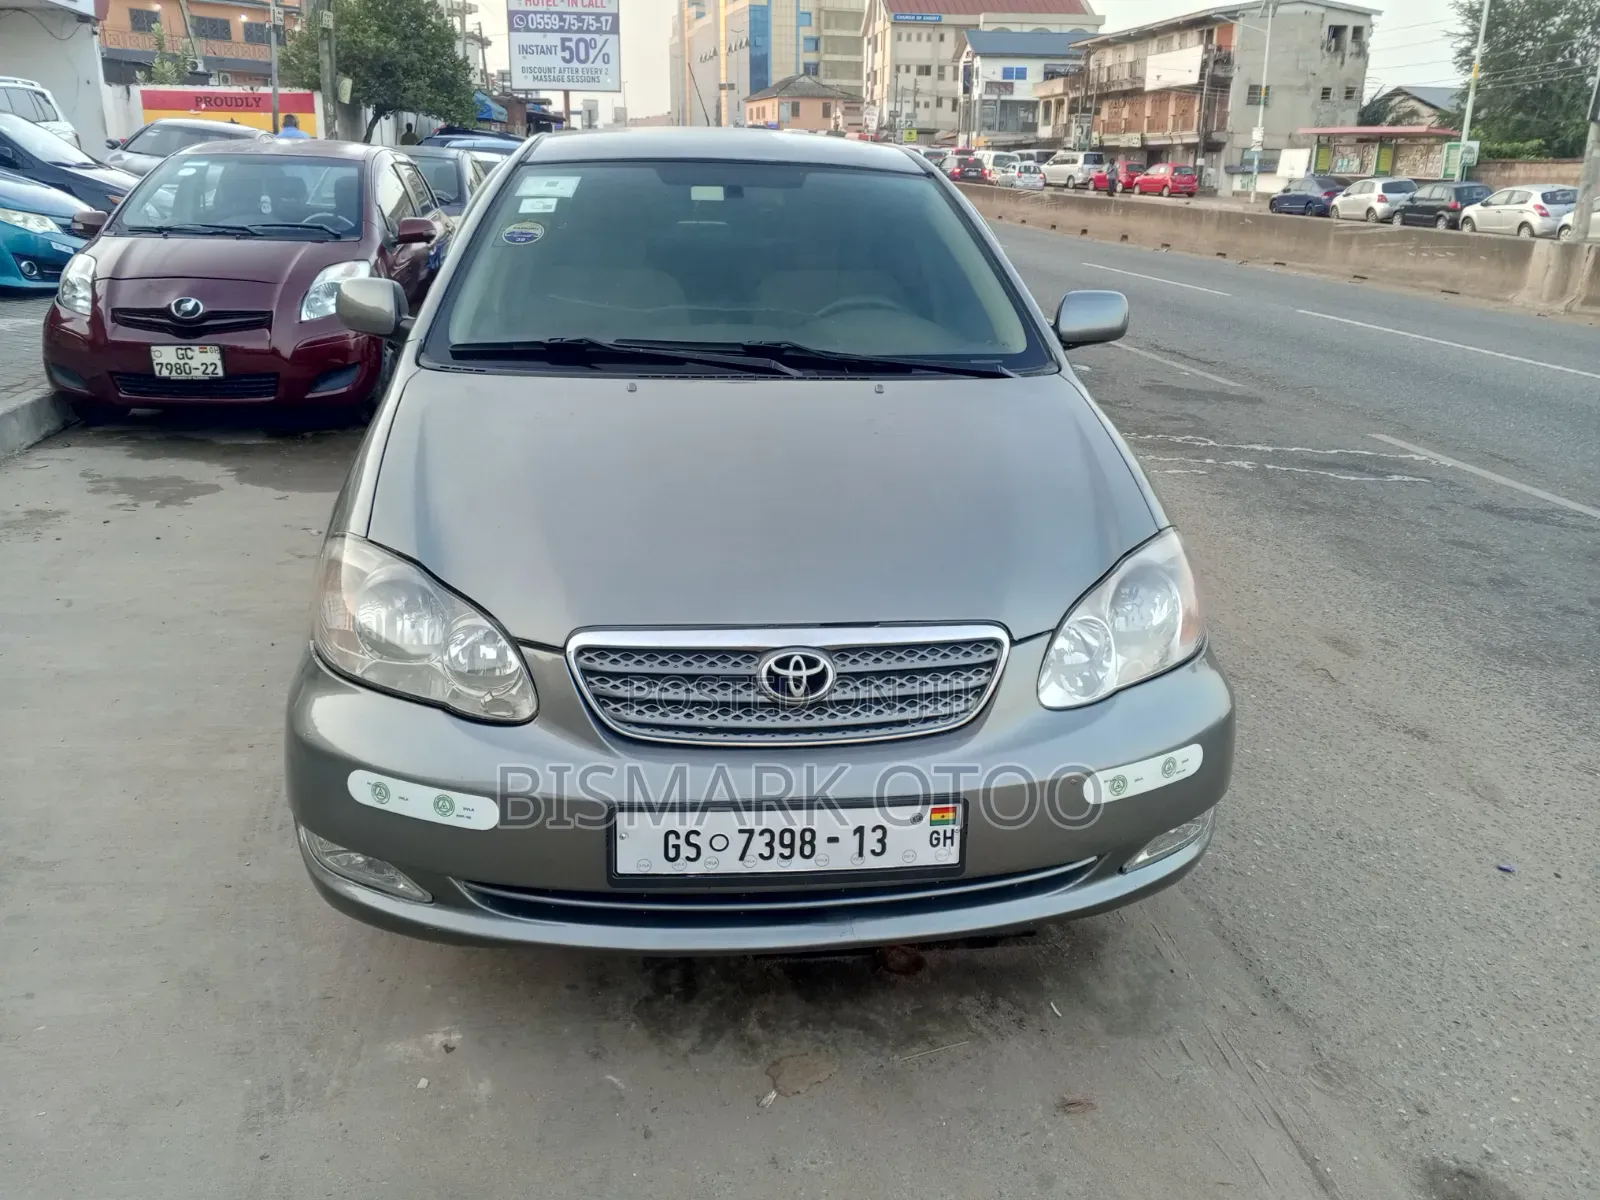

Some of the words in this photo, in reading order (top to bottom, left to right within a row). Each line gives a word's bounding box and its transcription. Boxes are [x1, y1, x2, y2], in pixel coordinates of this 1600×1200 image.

[528, 13, 612, 31] 0559-75-75-17
[518, 44, 558, 56] INSTANT
[560, 37, 610, 64] 50%
[521, 66, 556, 74] DISCOUNT
[559, 66, 579, 75] AFTER
[581, 67, 602, 75] EVERY
[532, 74, 565, 82] MASSAGE
[566, 75, 600, 83] SESSIONS
[195, 95, 262, 107] PROUDLY
[176, 347, 195, 360] GC
[156, 362, 219, 376] 7980-22
[663, 829, 702, 862] GS
[738, 826, 817, 862] 7398
[852, 824, 888, 858] 13
[929, 828, 955, 848] GH
